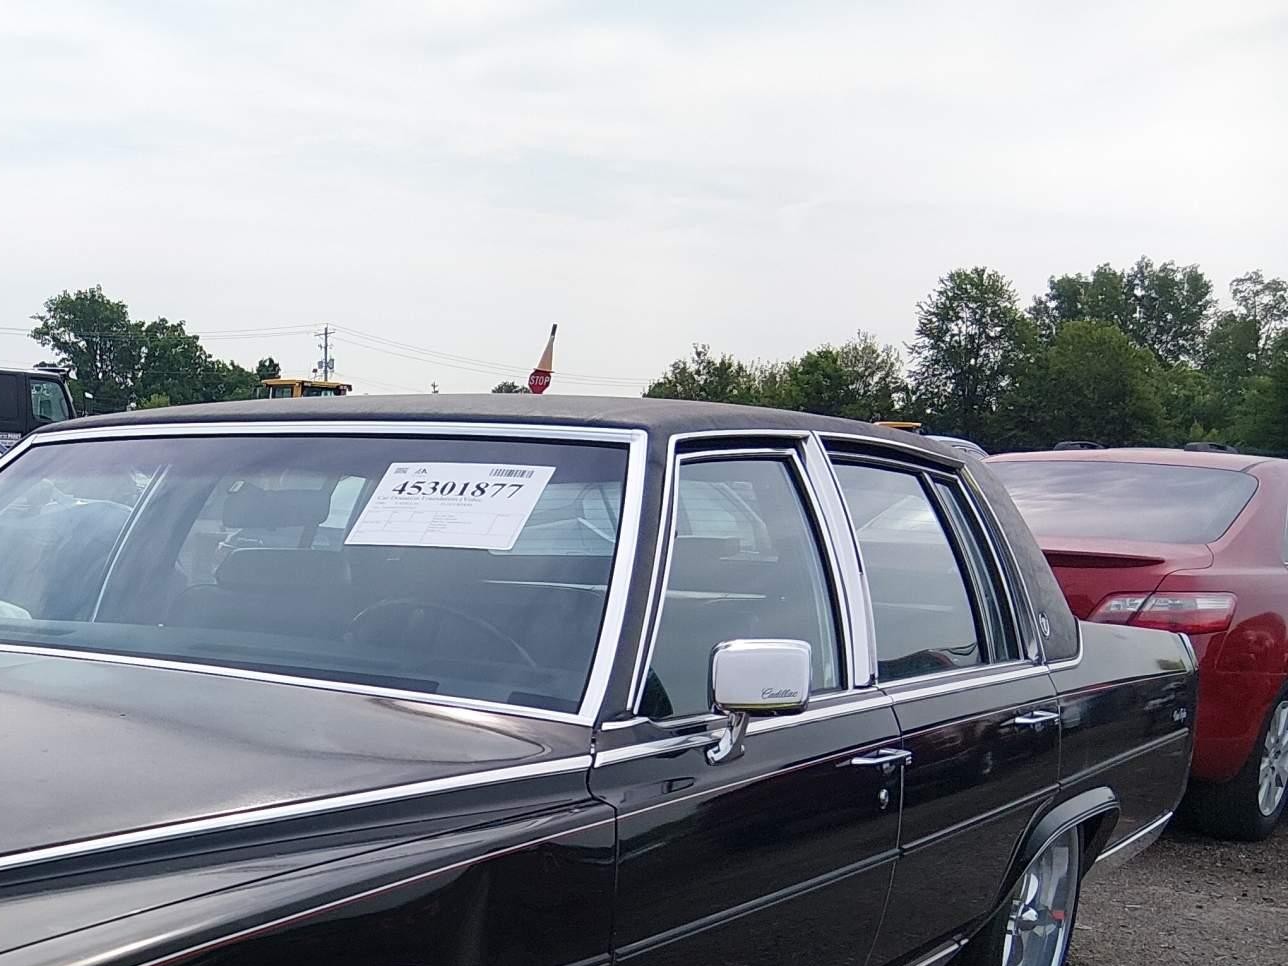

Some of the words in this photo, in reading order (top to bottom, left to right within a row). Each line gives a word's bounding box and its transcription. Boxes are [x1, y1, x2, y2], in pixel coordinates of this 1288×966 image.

[530, 375, 550, 386] STOP
[392, 481, 524, 499] 45301877
[762, 688, 798, 699] Cadillac
